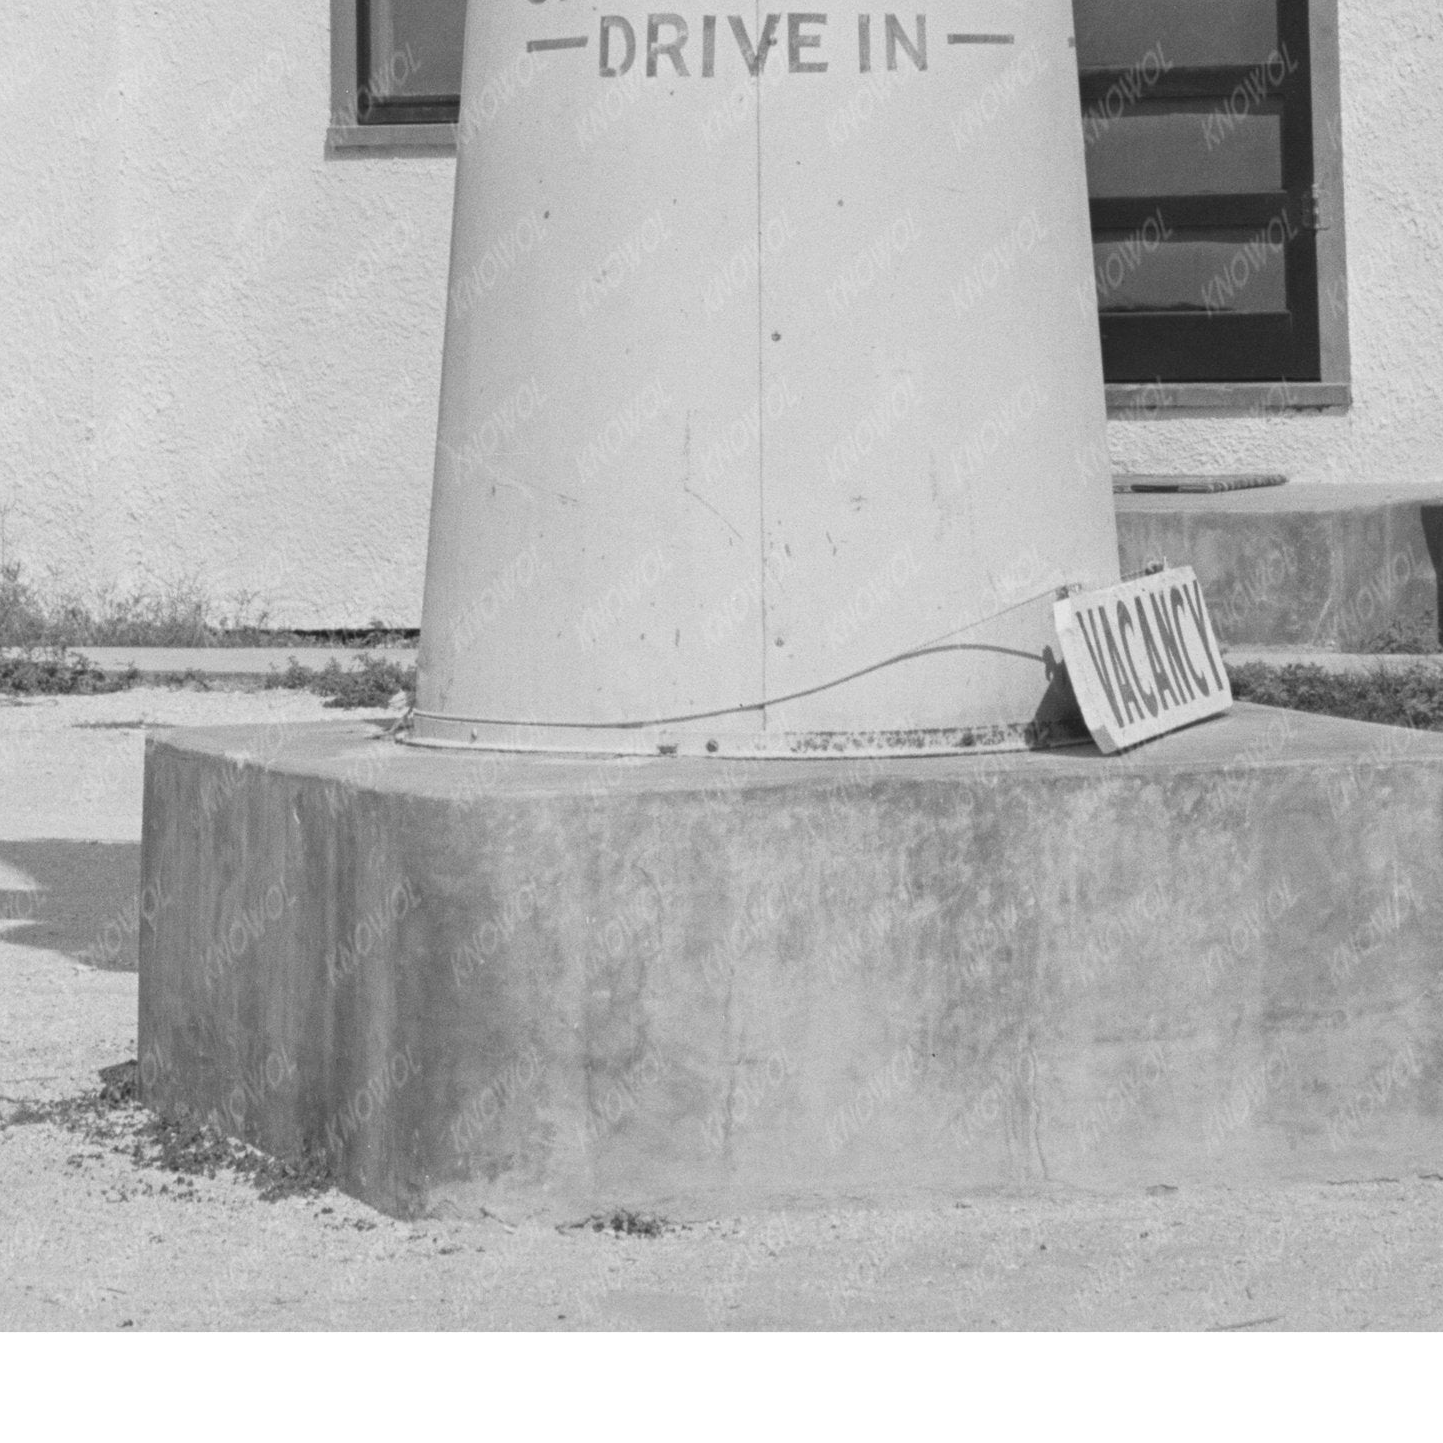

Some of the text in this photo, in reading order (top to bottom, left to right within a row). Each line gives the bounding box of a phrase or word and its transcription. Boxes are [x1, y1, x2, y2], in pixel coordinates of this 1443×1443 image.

[598, 13, 928, 78] DRIVE IN
[1075, 579, 1224, 728] VACANCY
